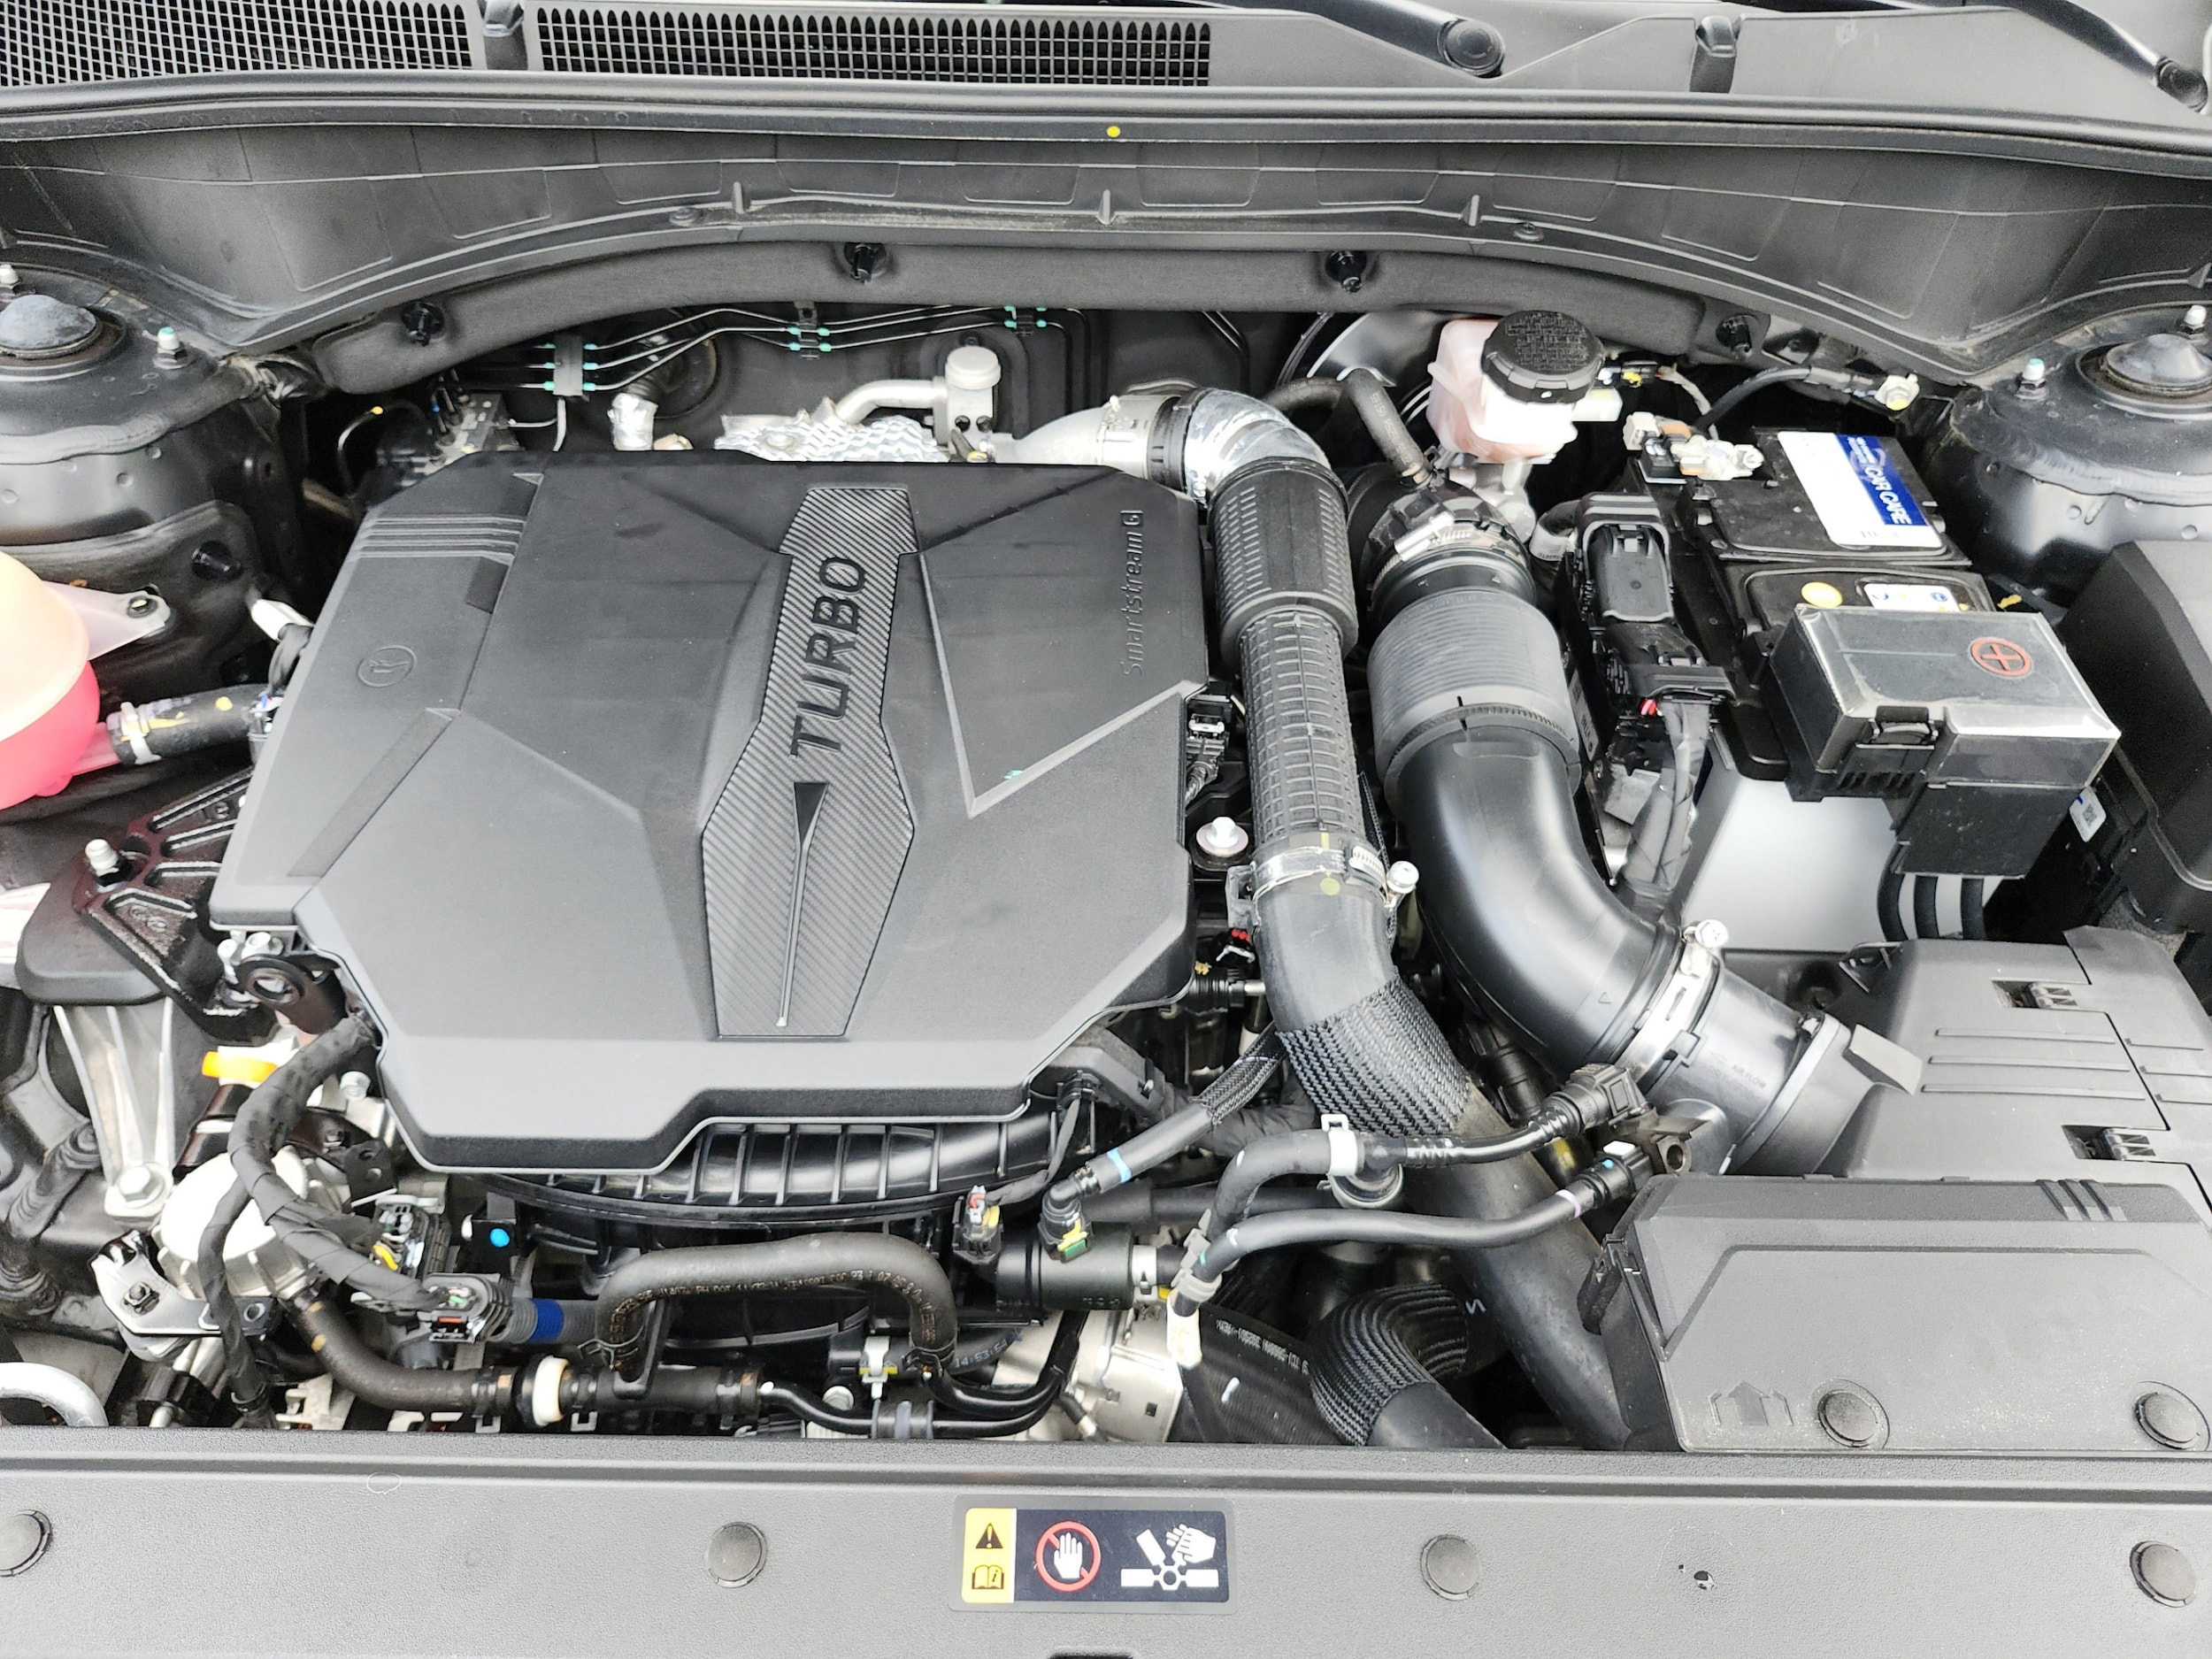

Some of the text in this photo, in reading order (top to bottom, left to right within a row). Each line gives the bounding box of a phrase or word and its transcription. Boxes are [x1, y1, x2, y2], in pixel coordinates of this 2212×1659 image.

[1865, 468, 1893, 492] CAR
[1879, 493, 1912, 524] CARE
[789, 557, 865, 757] TURBO
[1120, 531, 1143, 678] Smartstream
